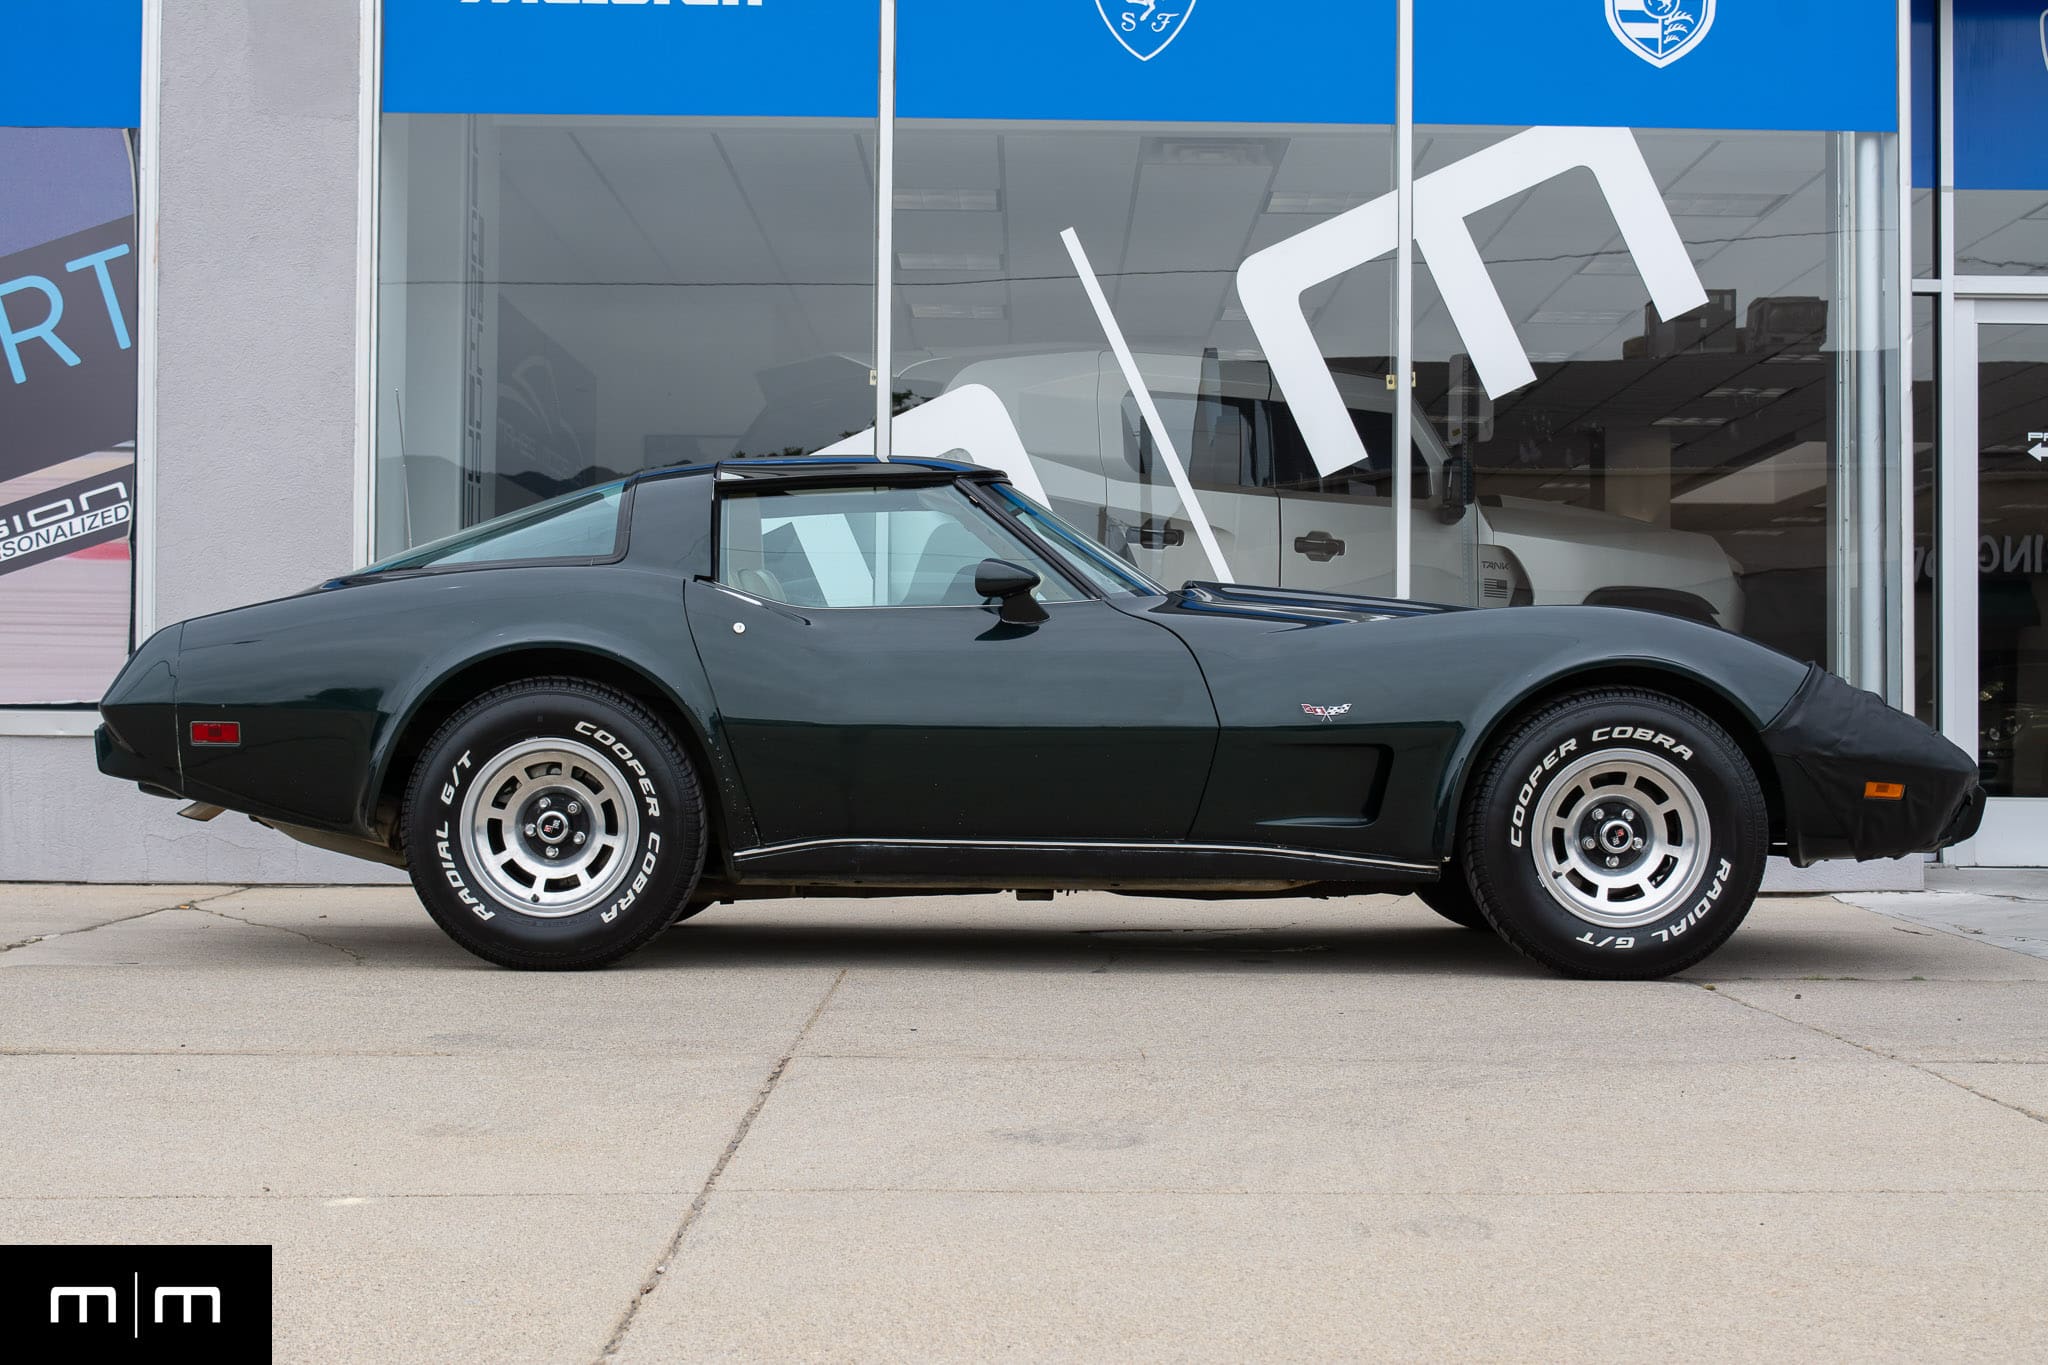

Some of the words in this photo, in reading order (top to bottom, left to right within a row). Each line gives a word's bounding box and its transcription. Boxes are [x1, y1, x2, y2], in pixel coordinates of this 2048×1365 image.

[0, 504, 130, 560] SONALIZED
[440, 749, 472, 806] G/T
[574, 720, 660, 817] COOPER
[1510, 738, 1578, 848] COOPER
[1591, 726, 1694, 761] COBRA
[435, 821, 496, 921] RADIAL
[600, 831, 661, 924] COBRA
[1650, 857, 1732, 942] RADIAL
[1575, 931, 1636, 949] G/T
